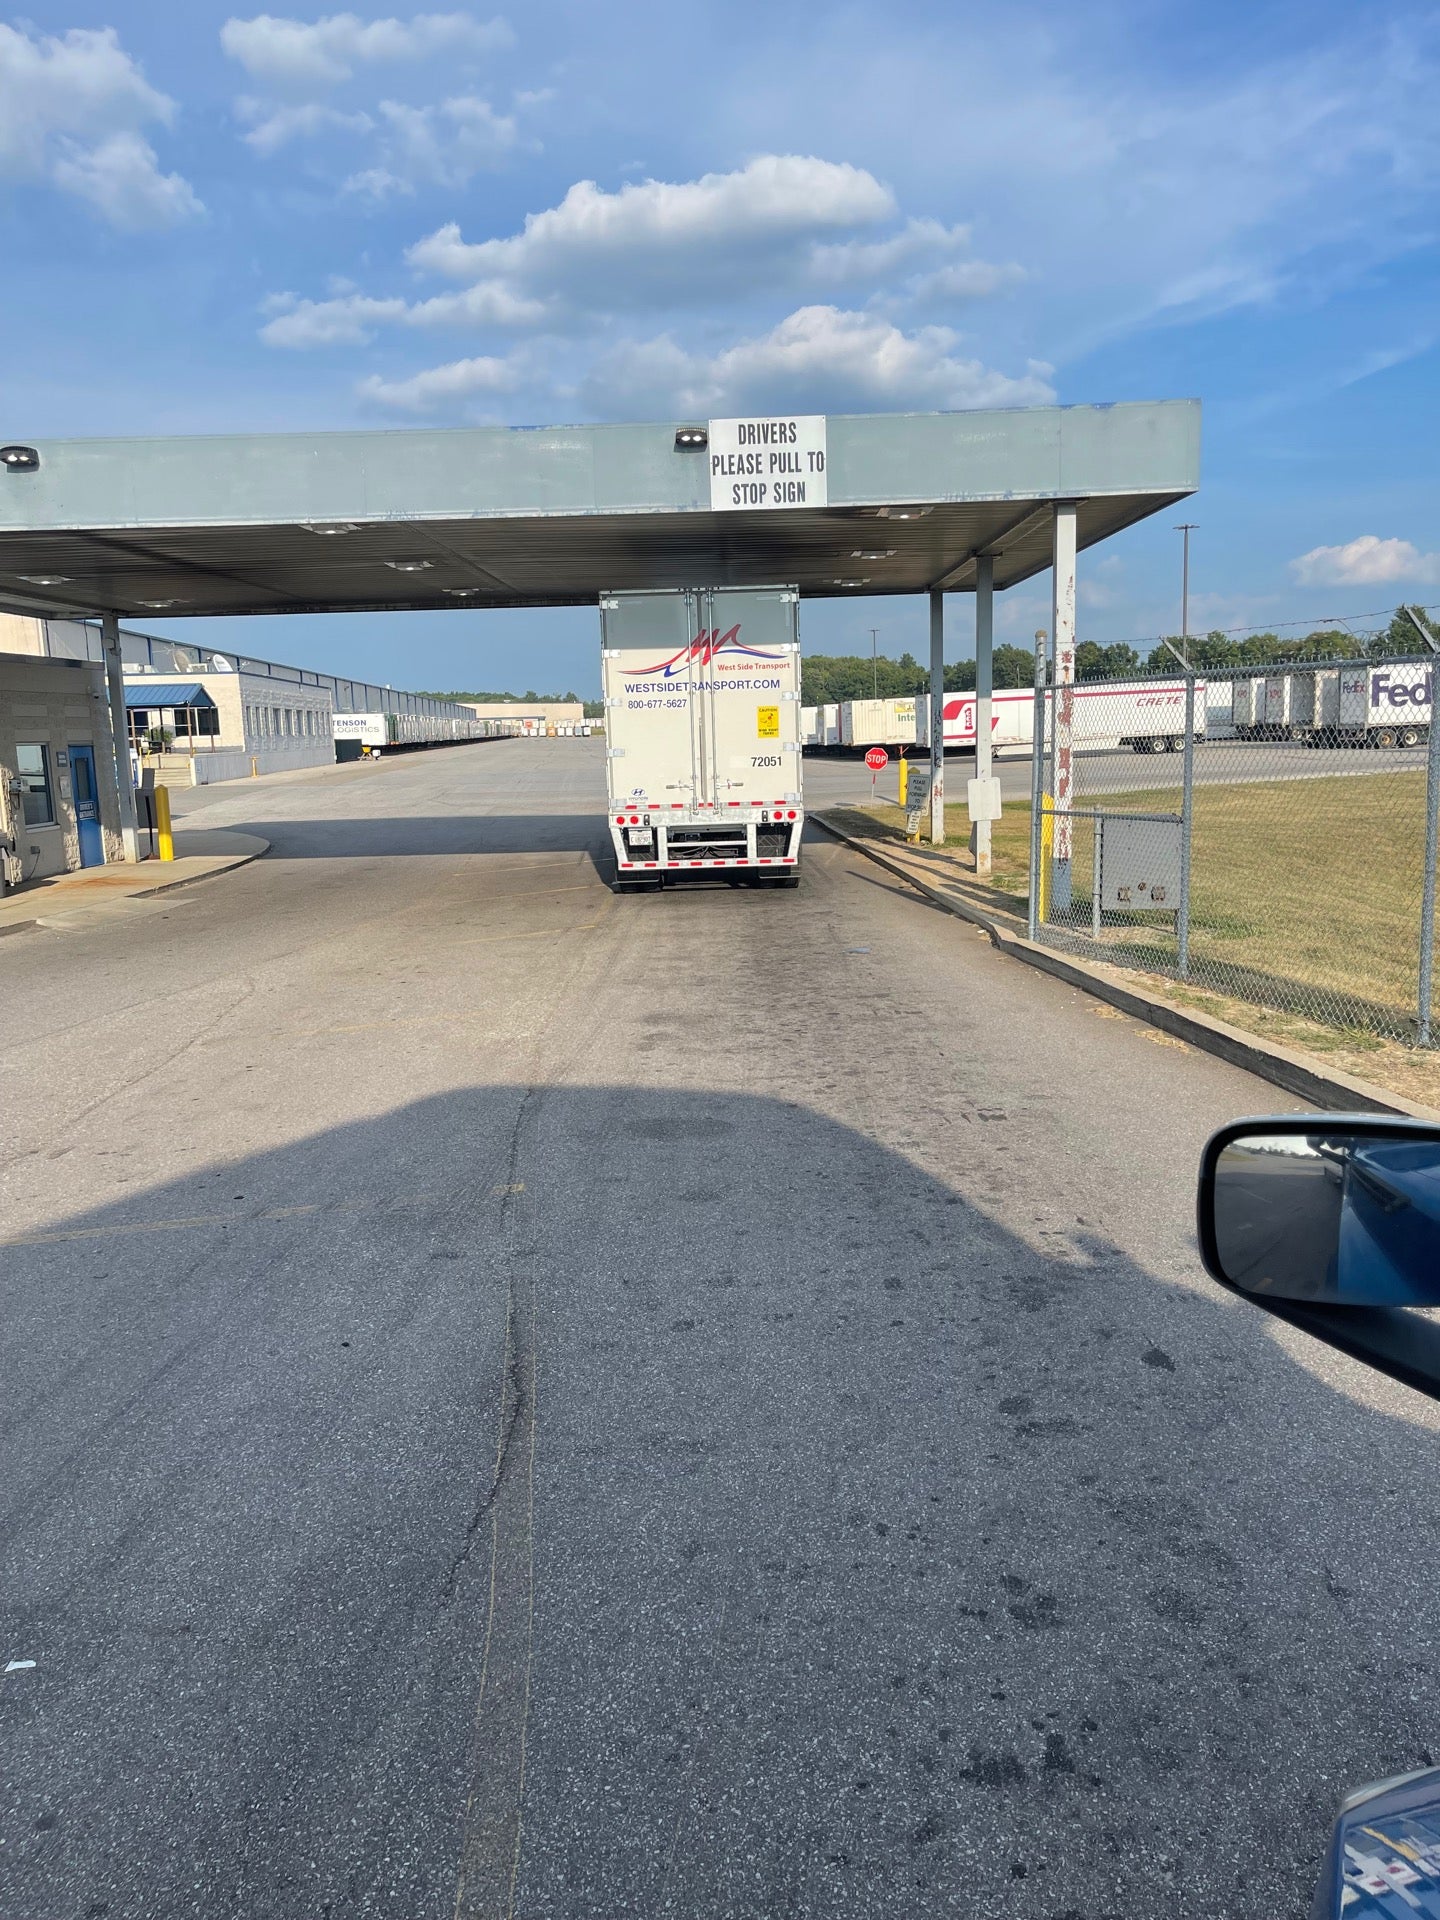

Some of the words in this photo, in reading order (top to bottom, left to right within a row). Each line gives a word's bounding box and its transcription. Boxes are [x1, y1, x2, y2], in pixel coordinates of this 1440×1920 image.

[738, 421, 797, 445] DRIVERS
[712, 453, 763, 476] PLEASE
[769, 452, 802, 474] PULL
[807, 450, 825, 473] TO
[732, 483, 767, 505] STOP
[773, 481, 806, 504] SIGN
[717, 663, 736, 671] West
[755, 662, 791, 671] Transport
[624, 679, 780, 693] WESTSIDETRANSPORT.COM
[1371, 672, 1432, 708] Fed
[627, 699, 688, 709] 800-677-5627
[750, 756, 783, 768] 72051
[866, 754, 887, 764] STOP
